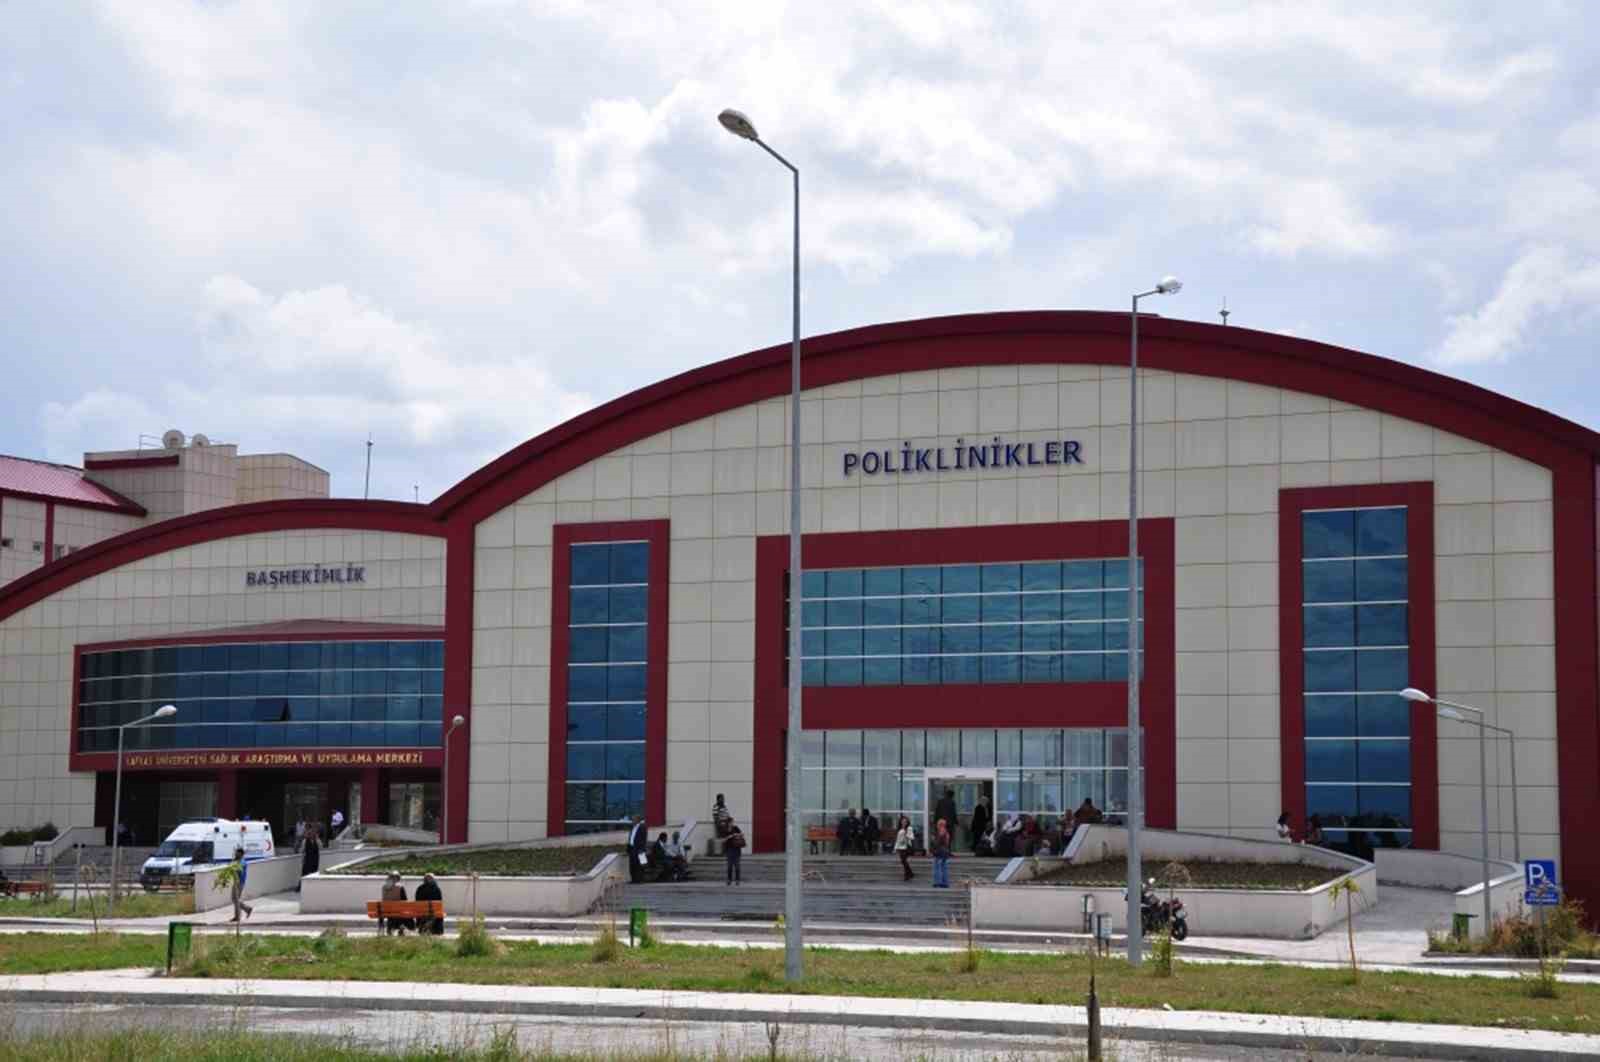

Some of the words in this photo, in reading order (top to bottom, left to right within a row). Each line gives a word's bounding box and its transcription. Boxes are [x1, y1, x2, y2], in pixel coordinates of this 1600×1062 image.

[843, 437, 1084, 475] POLİKLİNİKLER
[246, 562, 366, 588] BAŞHEKİMLİK
[245, 752, 298, 765] ARAŞTIRMA
[302, 753, 314, 764] VE
[376, 751, 424, 764] MERKEZİ
[1528, 863, 1545, 885] P
